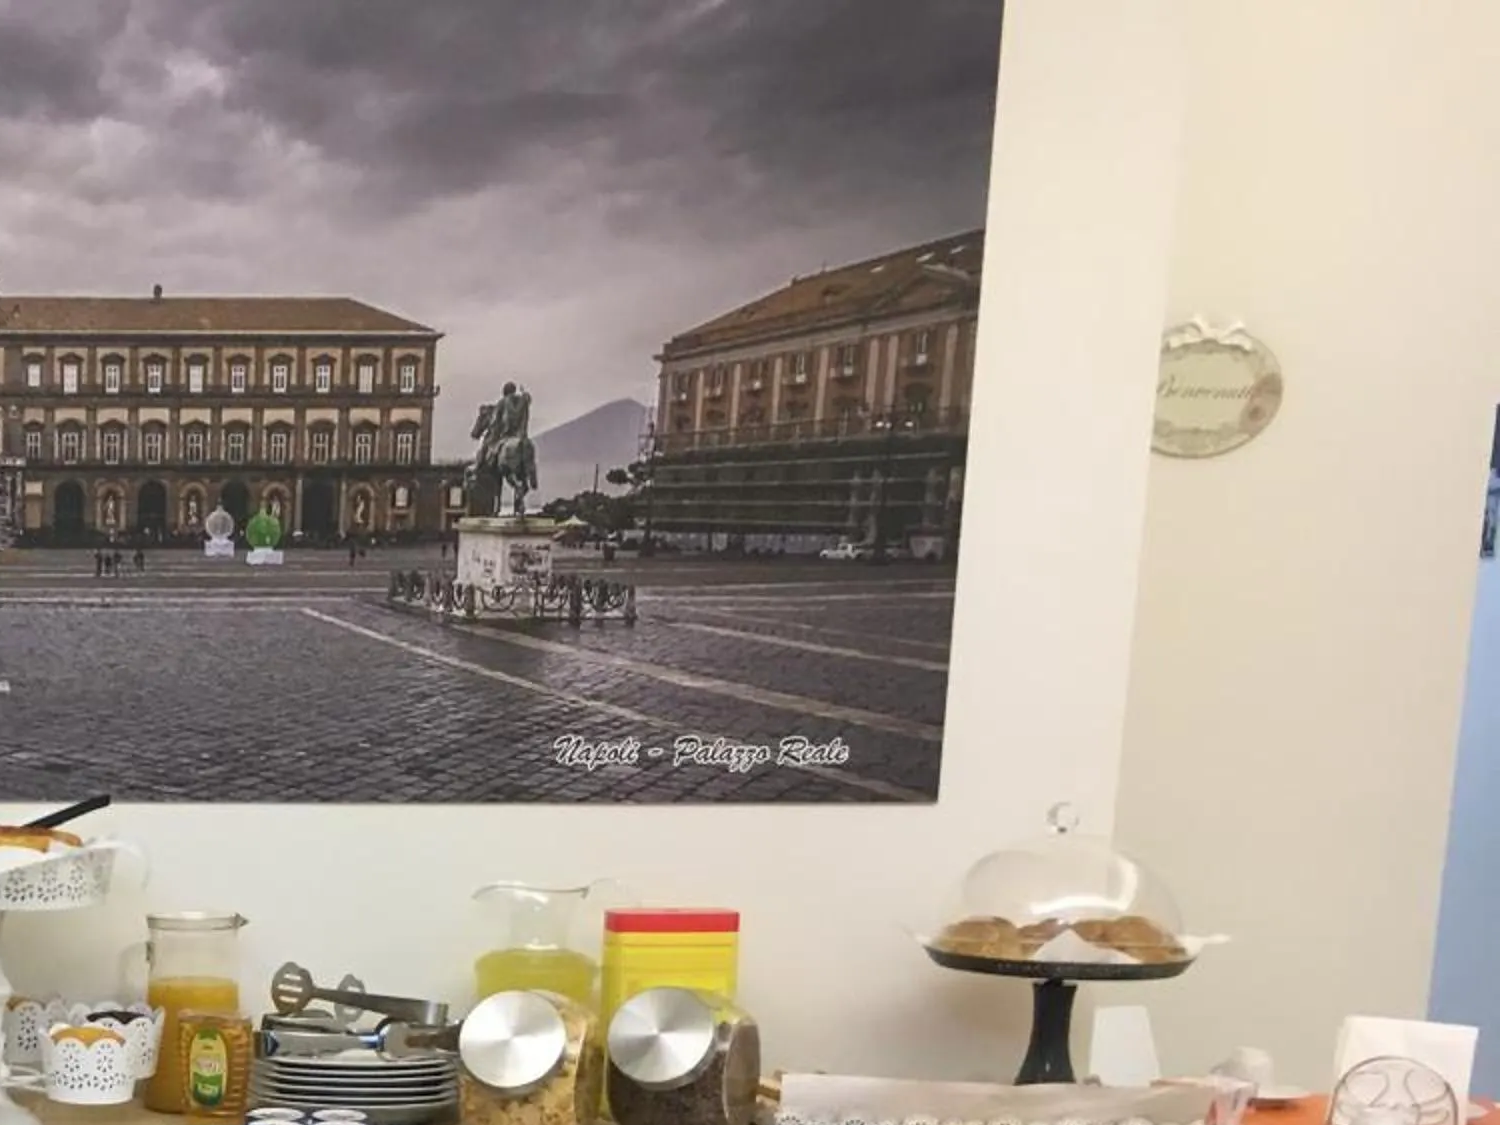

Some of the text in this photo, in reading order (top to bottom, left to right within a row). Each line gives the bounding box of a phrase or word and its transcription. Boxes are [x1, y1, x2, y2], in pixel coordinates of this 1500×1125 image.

[553, 734, 640, 771] Napoli
[673, 735, 771, 773] Palazzo
[776, 735, 849, 766] Reale
